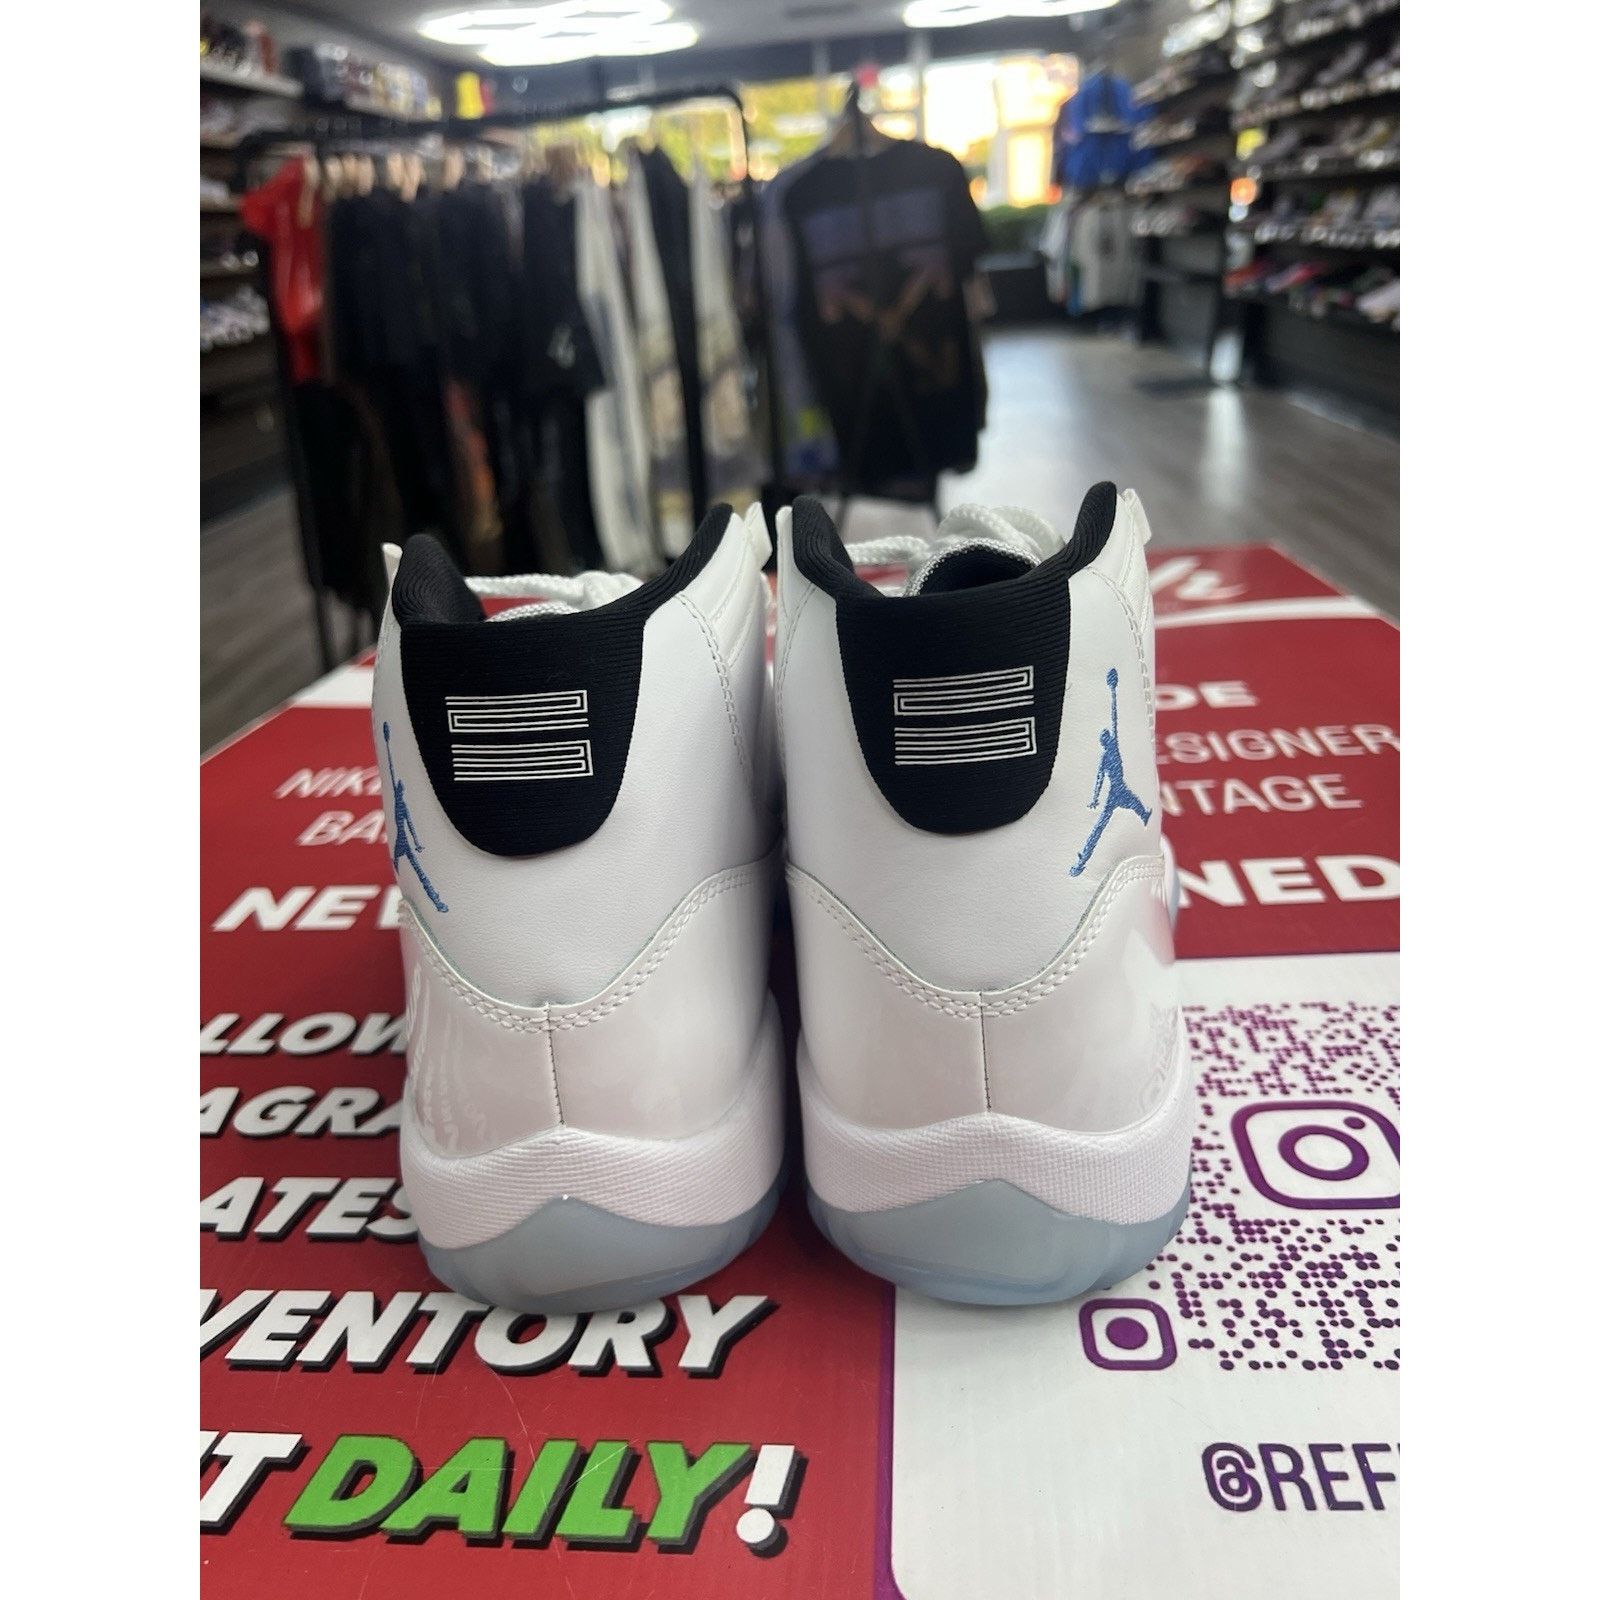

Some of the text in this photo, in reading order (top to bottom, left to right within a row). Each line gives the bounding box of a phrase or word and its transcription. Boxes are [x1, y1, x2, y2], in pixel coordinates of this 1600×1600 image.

[1156, 724, 1400, 766] SIGNER
[297, 810, 388, 846] BA
[200, 1430, 796, 1544] T DAILY!
[1201, 1442, 1400, 1512] @REF
